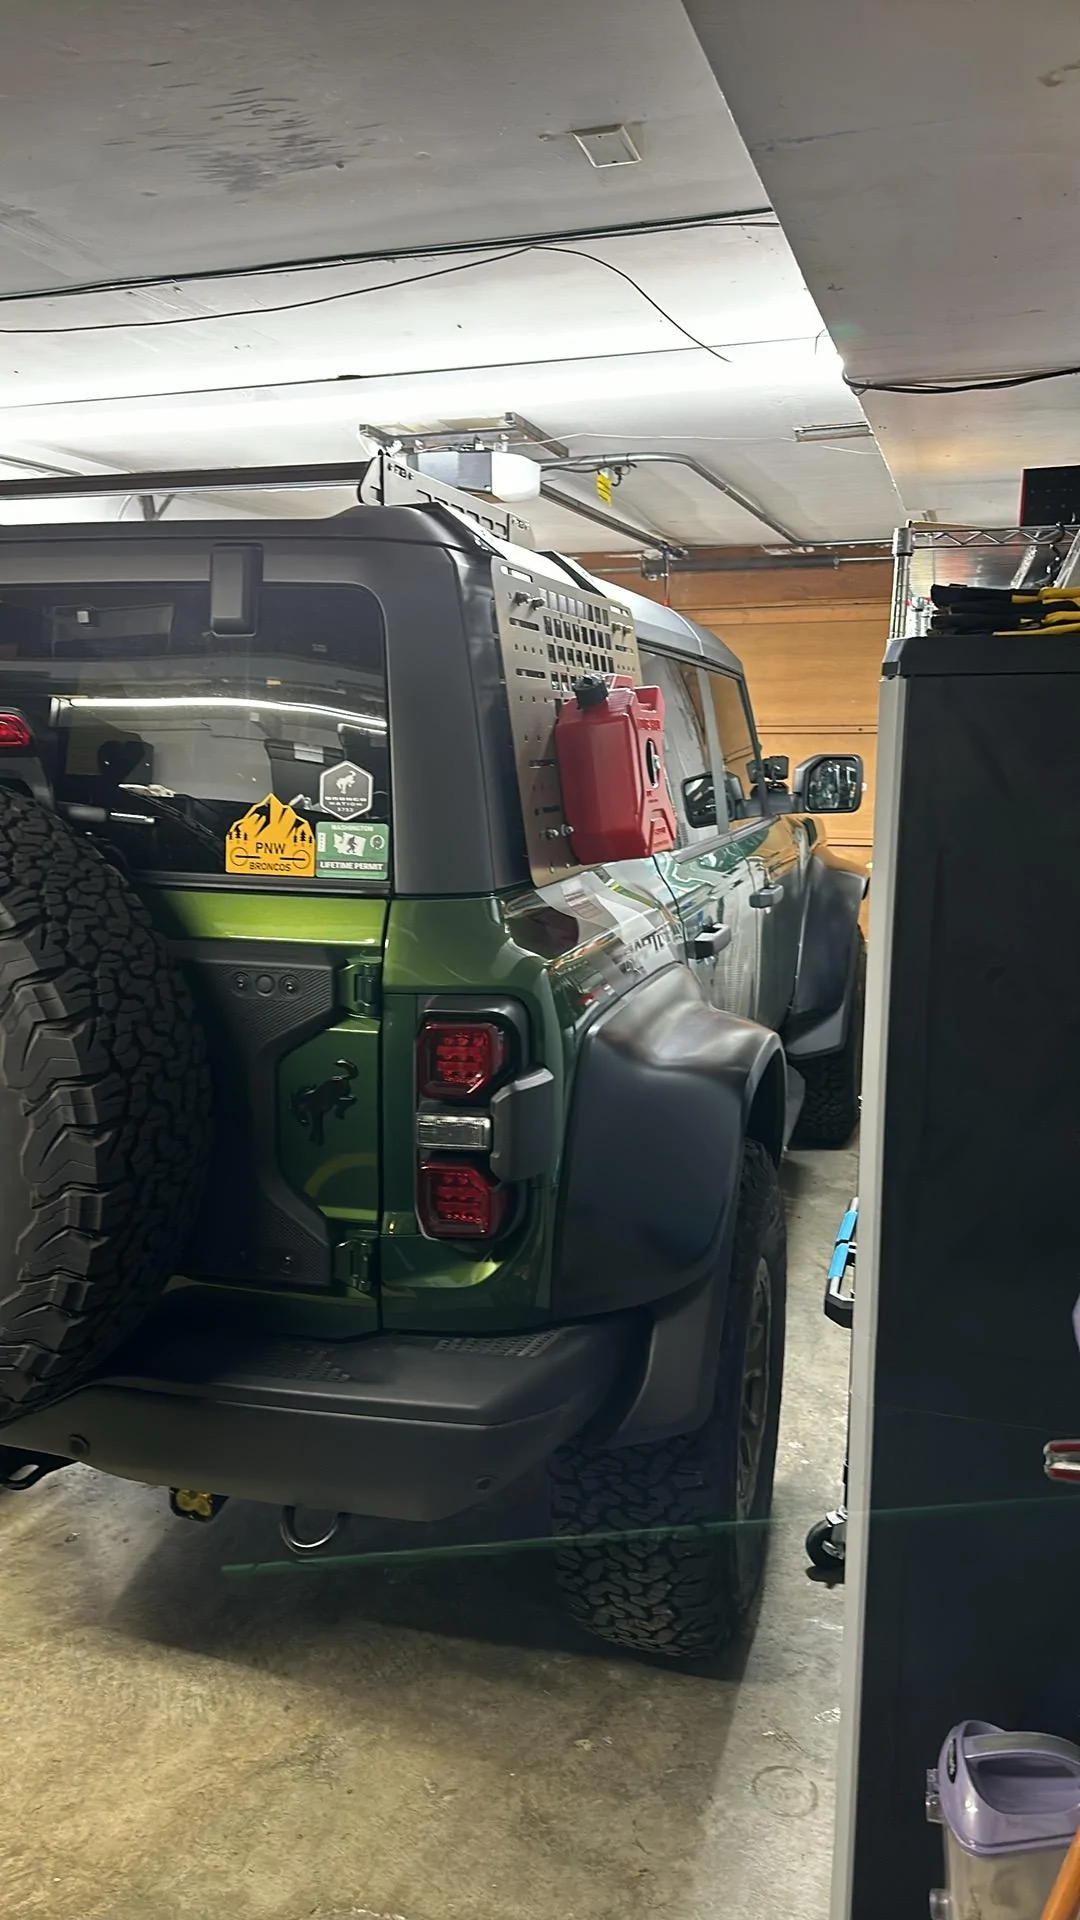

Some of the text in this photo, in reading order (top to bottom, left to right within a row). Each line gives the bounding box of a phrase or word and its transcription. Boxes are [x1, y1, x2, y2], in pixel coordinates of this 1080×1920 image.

[256, 842, 285, 854] PNW
[249, 862, 291, 872] BRONCOS
[320, 861, 384, 871] LIFETIME PERMIT
